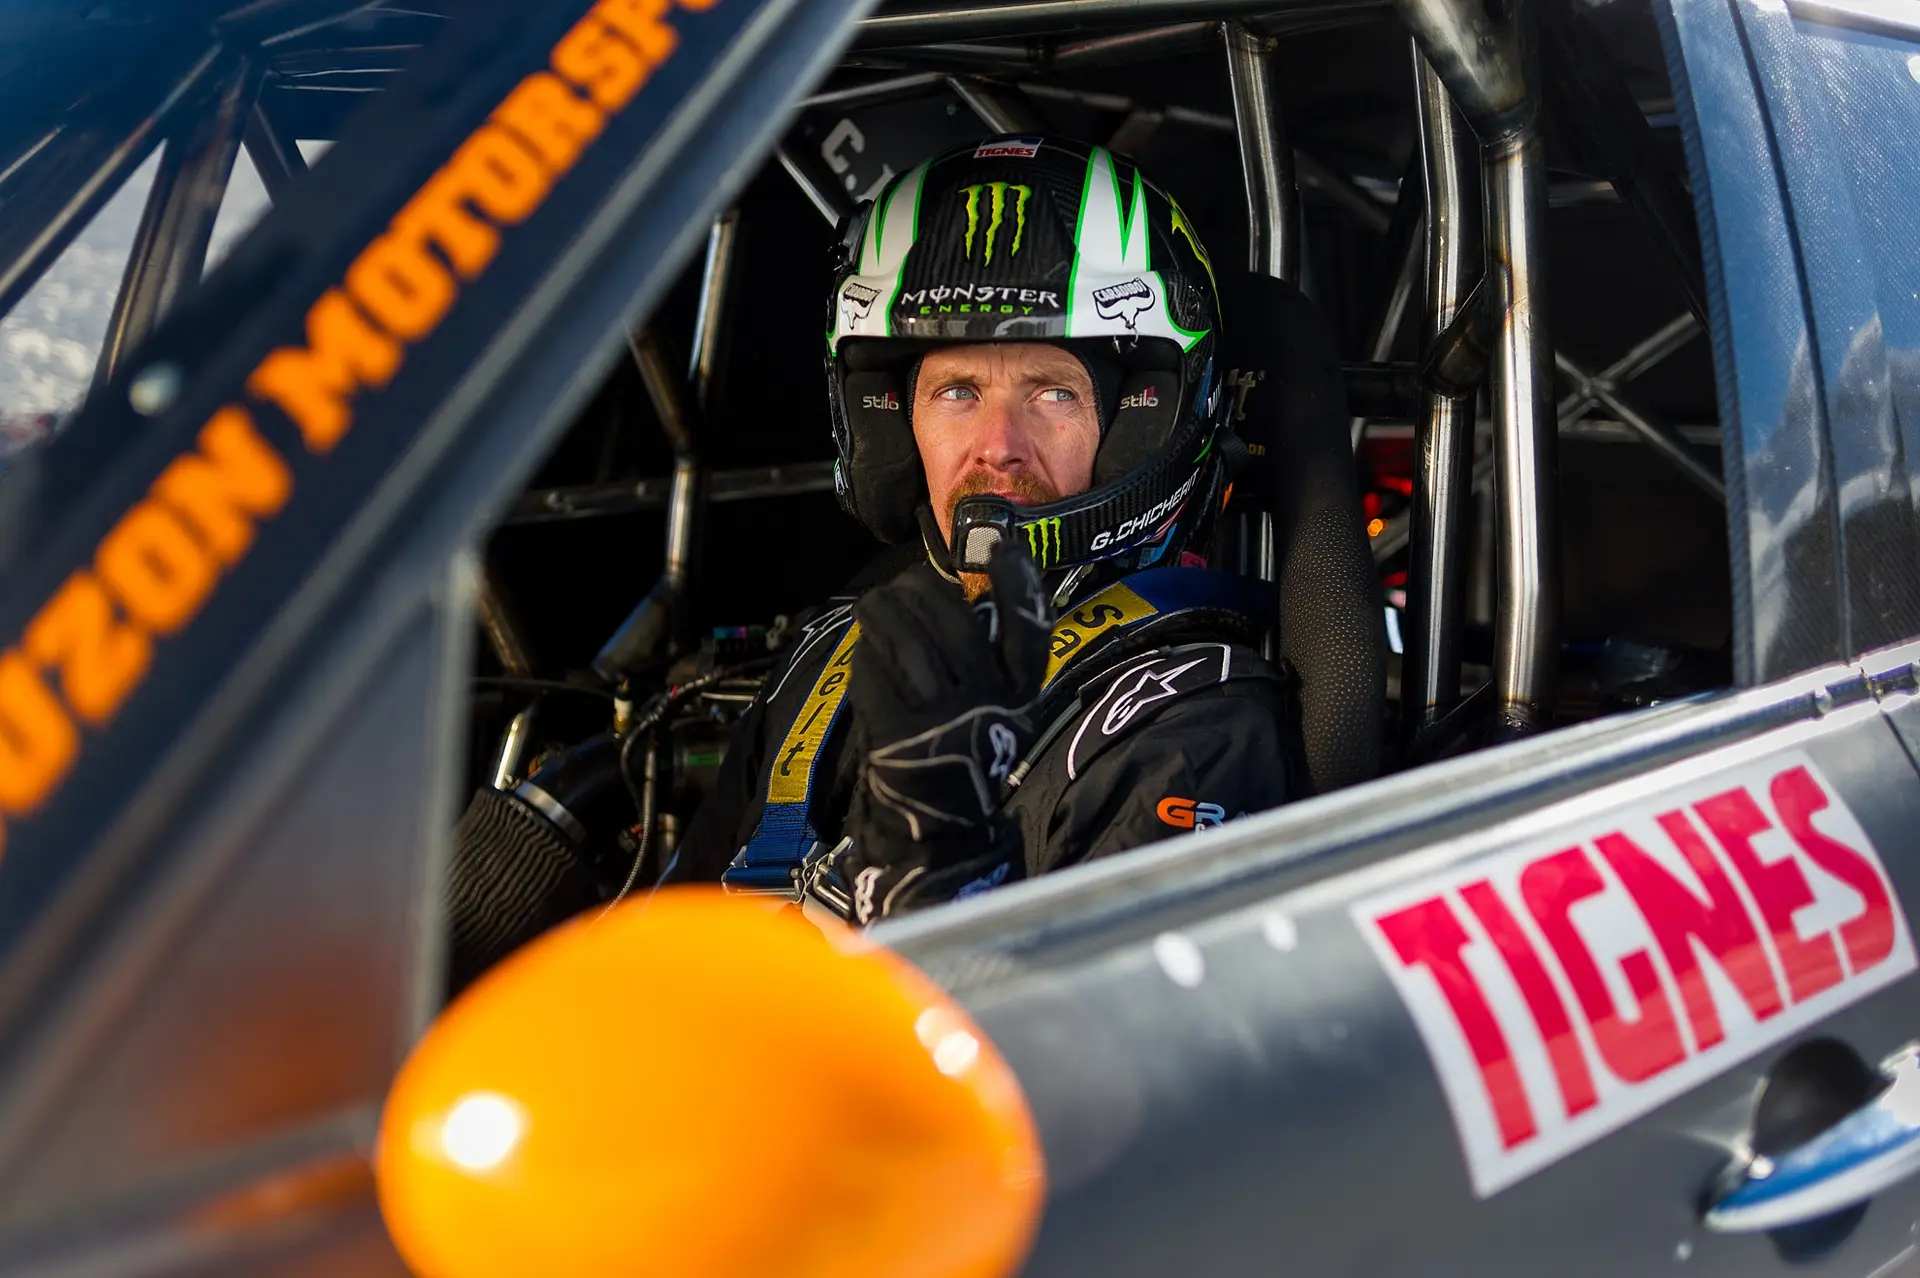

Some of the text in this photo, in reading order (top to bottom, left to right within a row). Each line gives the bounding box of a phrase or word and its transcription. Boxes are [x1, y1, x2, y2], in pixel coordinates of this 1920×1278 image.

[977, 147, 1034, 157] TIGNES
[919, 303, 1033, 315] ENERGY
[863, 392, 899, 410] stilo
[1119, 388, 1159, 410] stilo
[0, 0, 725, 858] UZON MOTORSP
[1373, 764, 1896, 1153] TIGNES
